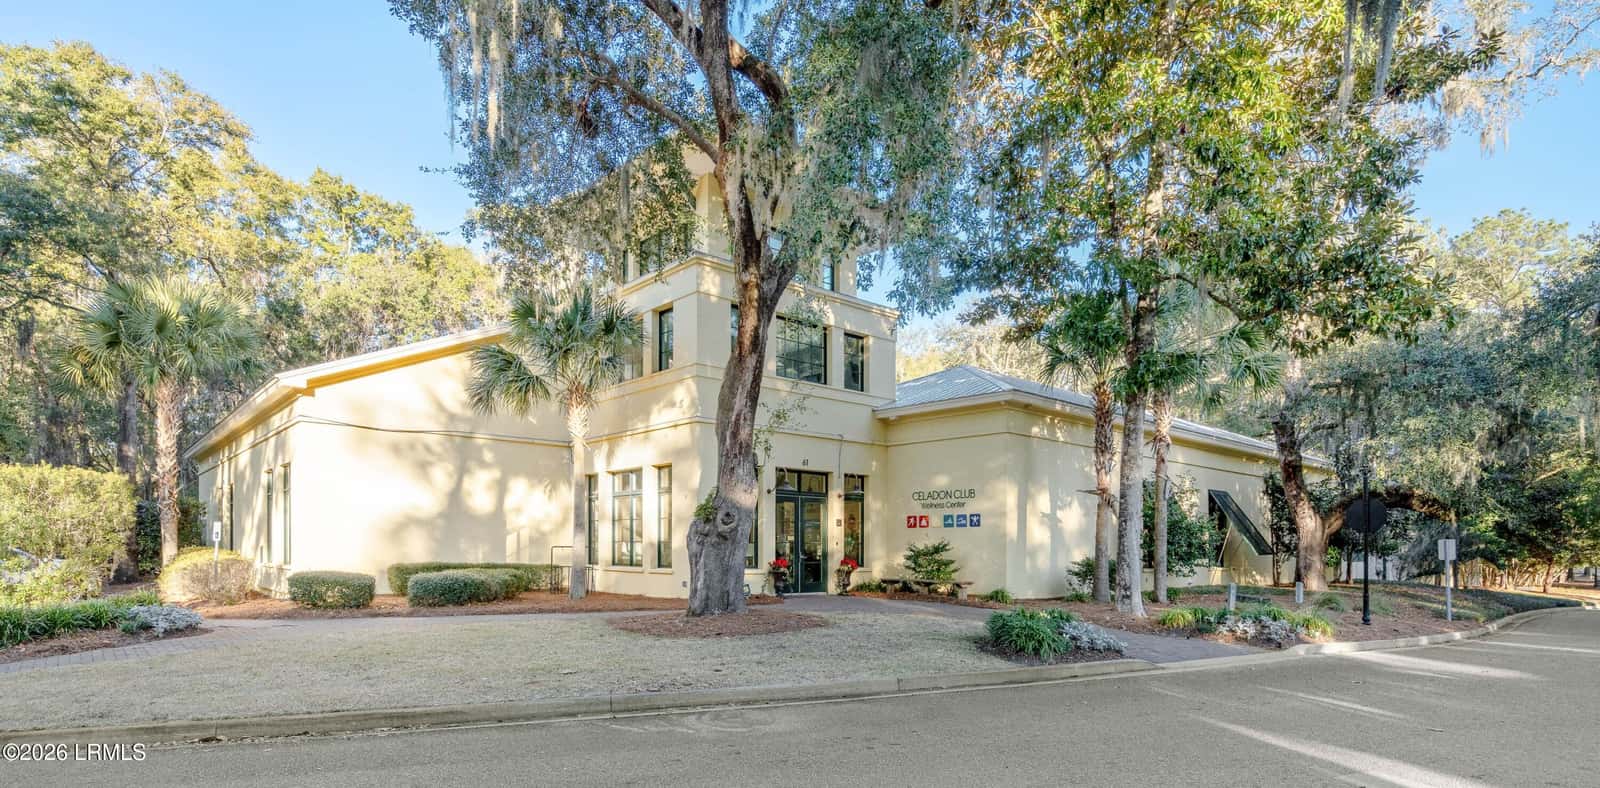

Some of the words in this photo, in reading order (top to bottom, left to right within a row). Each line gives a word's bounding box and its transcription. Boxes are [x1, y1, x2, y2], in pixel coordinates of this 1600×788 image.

[912, 490, 952, 501] CELADON
[953, 488, 976, 499] CLUB
[945, 501, 966, 509] Center
